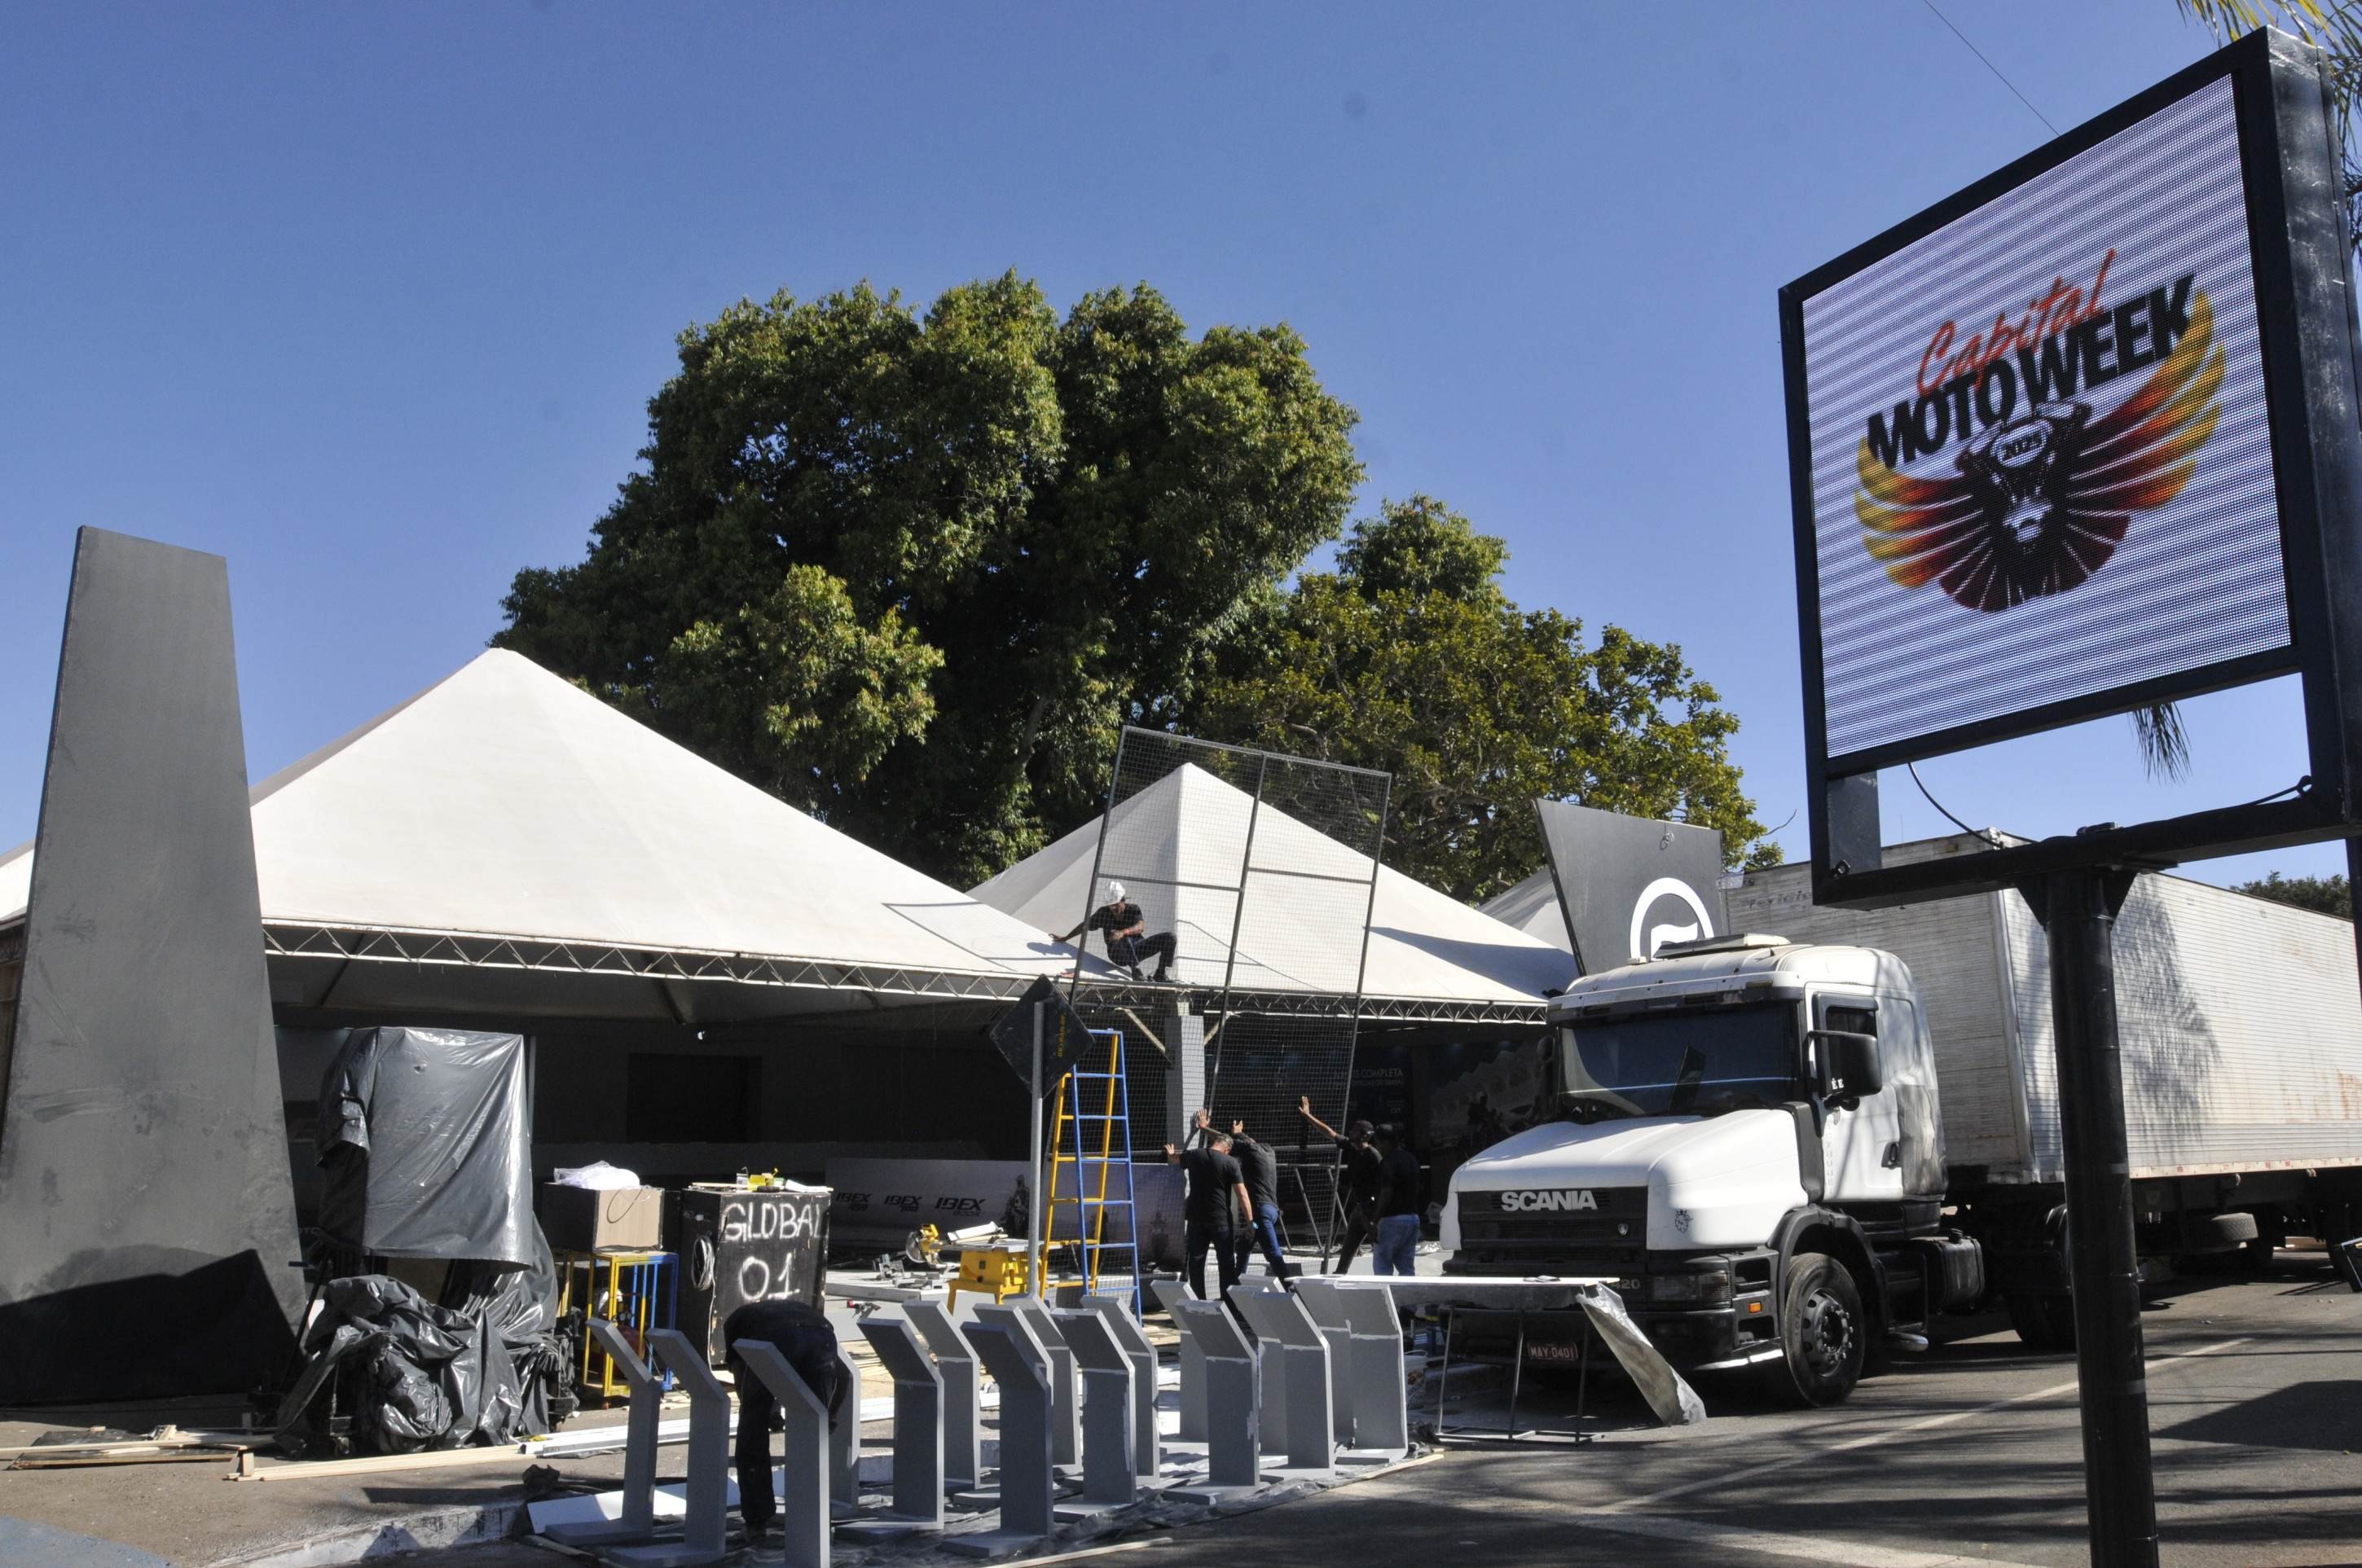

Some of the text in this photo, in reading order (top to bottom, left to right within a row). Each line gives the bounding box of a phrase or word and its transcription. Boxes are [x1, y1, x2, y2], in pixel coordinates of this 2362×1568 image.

[1916, 248, 2117, 397] Capital
[1361, 1068, 1403, 1078] COMPLETA
[835, 1192, 872, 1203] IBEX
[884, 1195, 922, 1206] IBEX
[935, 1197, 987, 1211] IBEX
[1501, 1189, 1599, 1213] SCANIA
[719, 1201, 829, 1243] GLOBAL
[1614, 1278, 1641, 1290] 20
